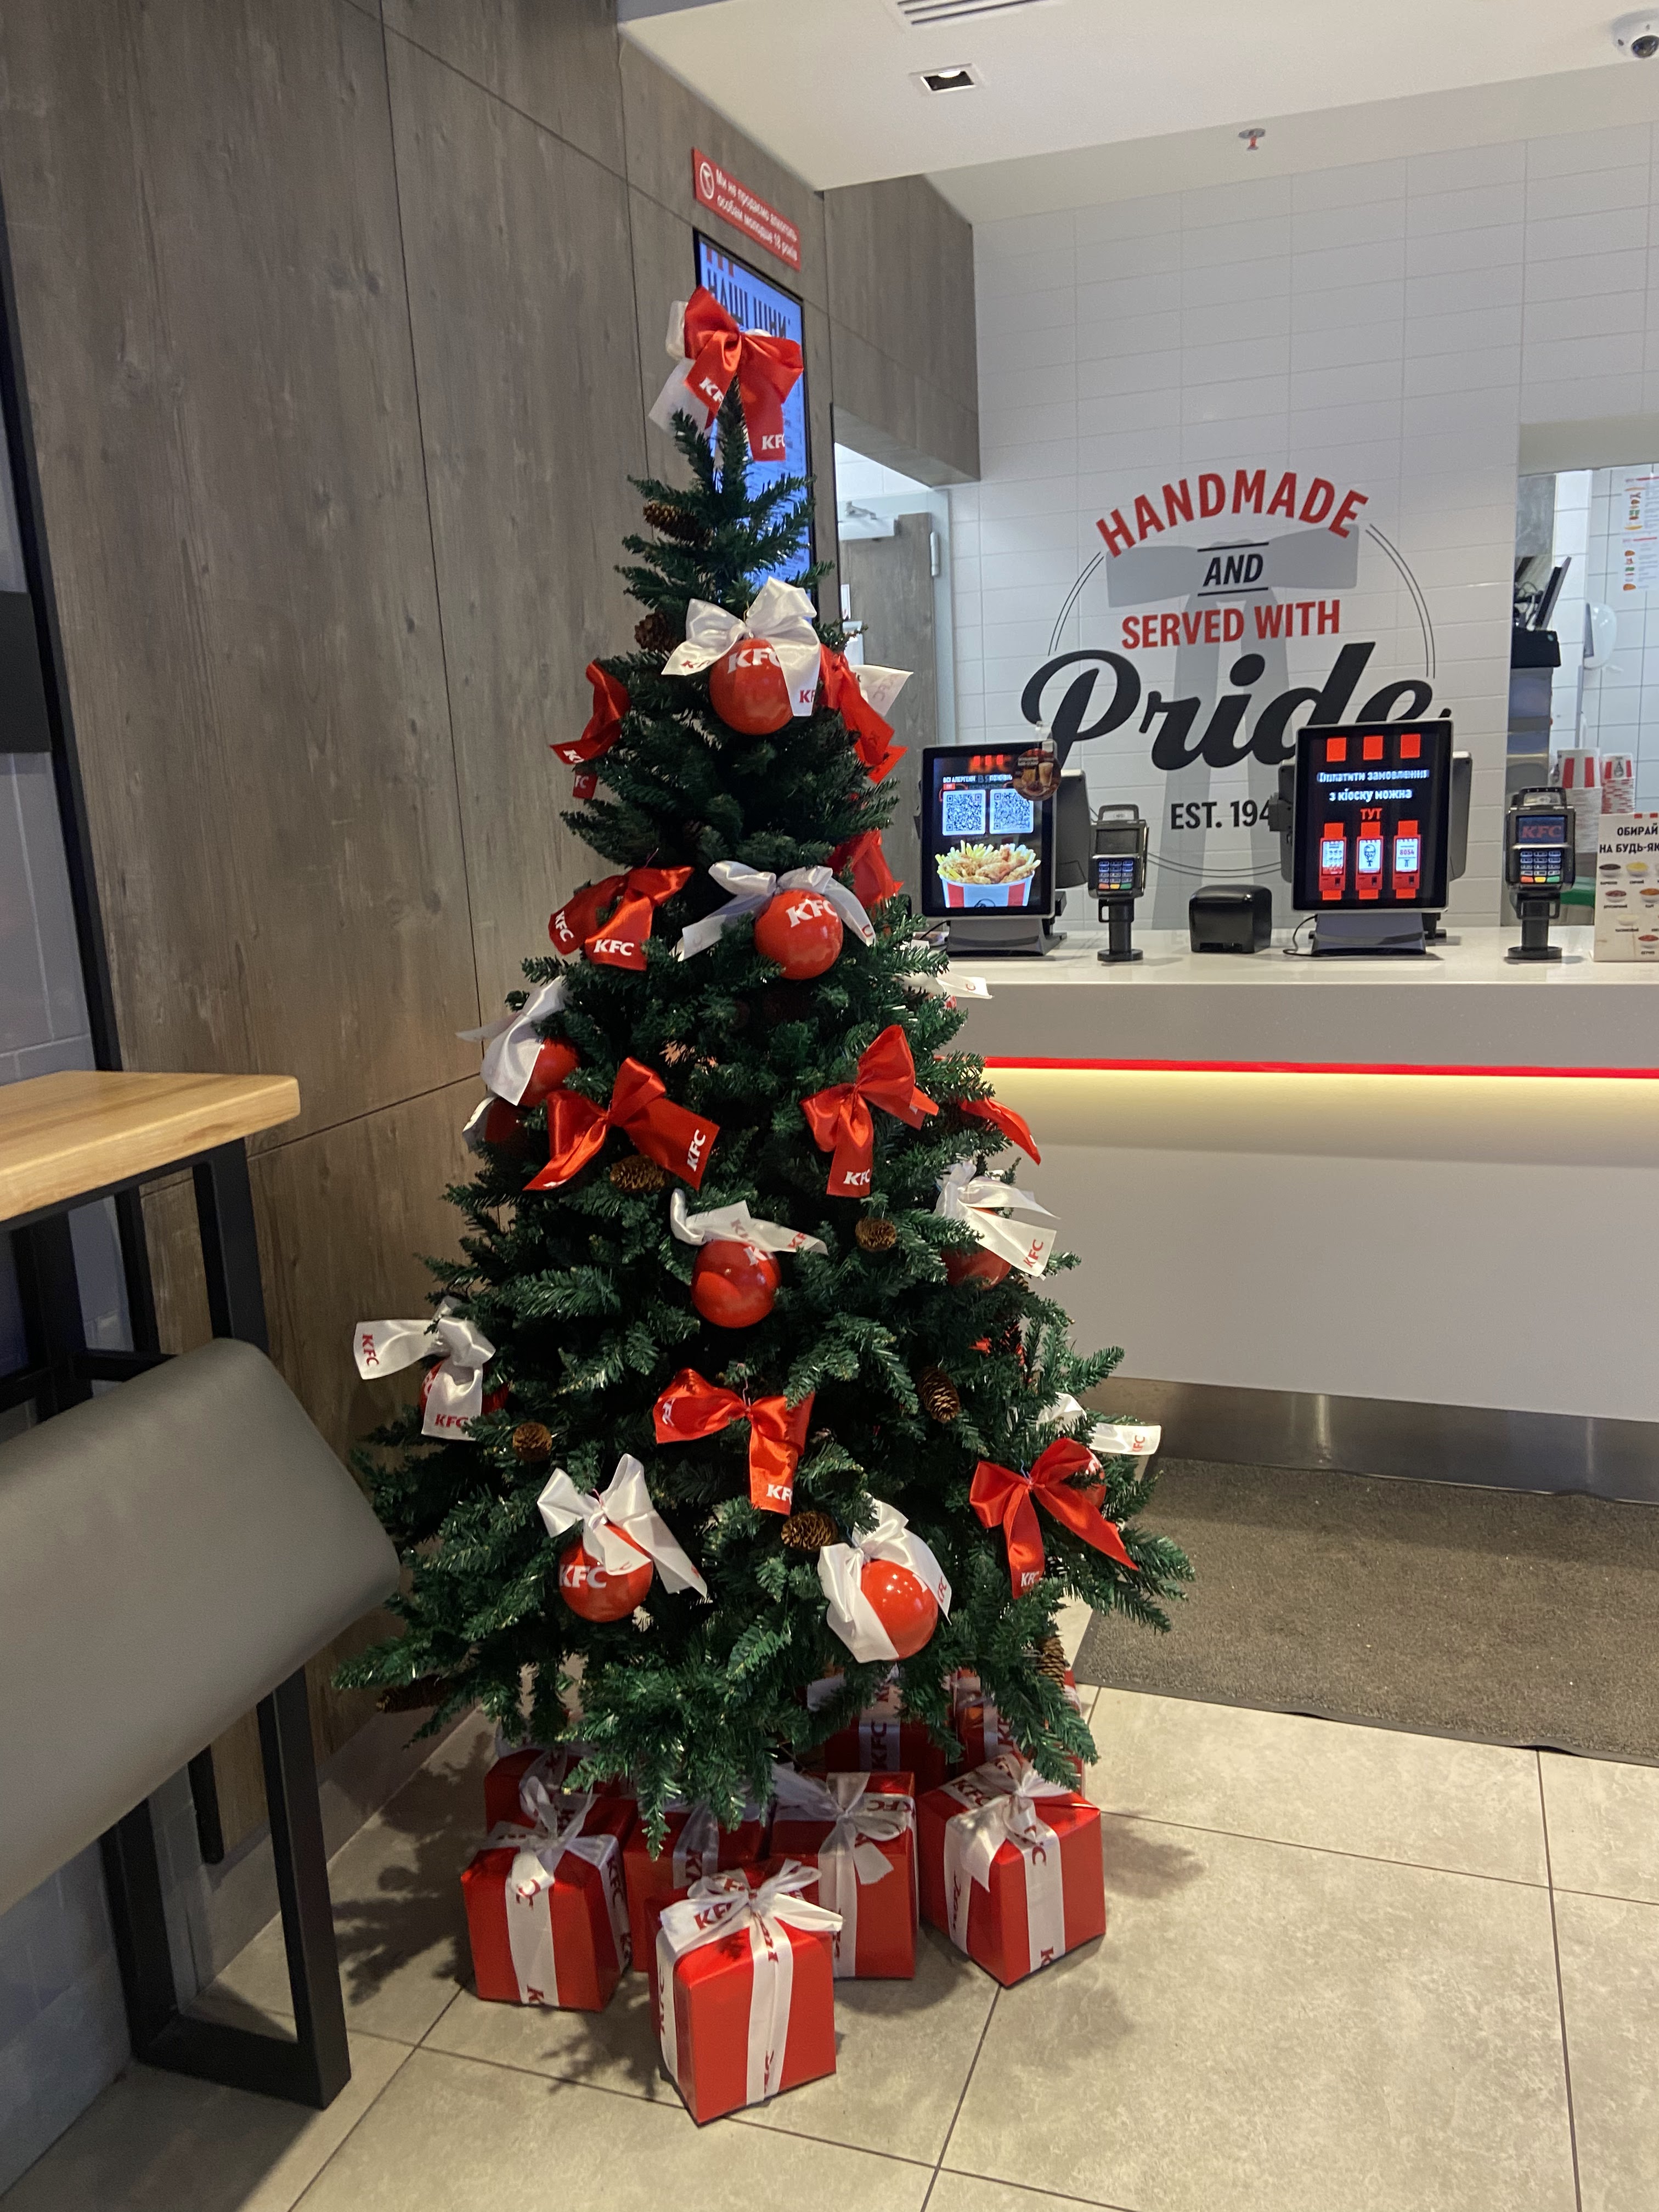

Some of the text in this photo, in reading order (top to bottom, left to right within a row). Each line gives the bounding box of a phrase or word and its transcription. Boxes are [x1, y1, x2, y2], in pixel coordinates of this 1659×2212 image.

[699, 376, 724, 402] KF
[1096, 469, 1369, 558] HANDMADE
[1203, 554, 1264, 586] AND
[1121, 599, 1340, 650] SERVED WITH
[799, 690, 816, 703] KF
[1338, 788, 1373, 803] кіоску
[1375, 789, 1413, 799] можна
[1170, 799, 1270, 830] EST. 194
[1522, 826, 1561, 838] KFC
[1617, 823, 1658, 836] ОБИРАЙ
[1599, 842, 1659, 854] НА БУДЬ-ЯК
[555, 910, 574, 943] KFC
[786, 899, 839, 928] KFC
[594, 939, 634, 956] KFC
[686, 1129, 707, 1172] KFC
[843, 1169, 871, 1186] KFC
[1023, 1238, 1043, 1268] KFC
[362, 1334, 379, 1366] KFC
[559, 1564, 607, 1589] KFC
[694, 1902, 732, 1931] KF
